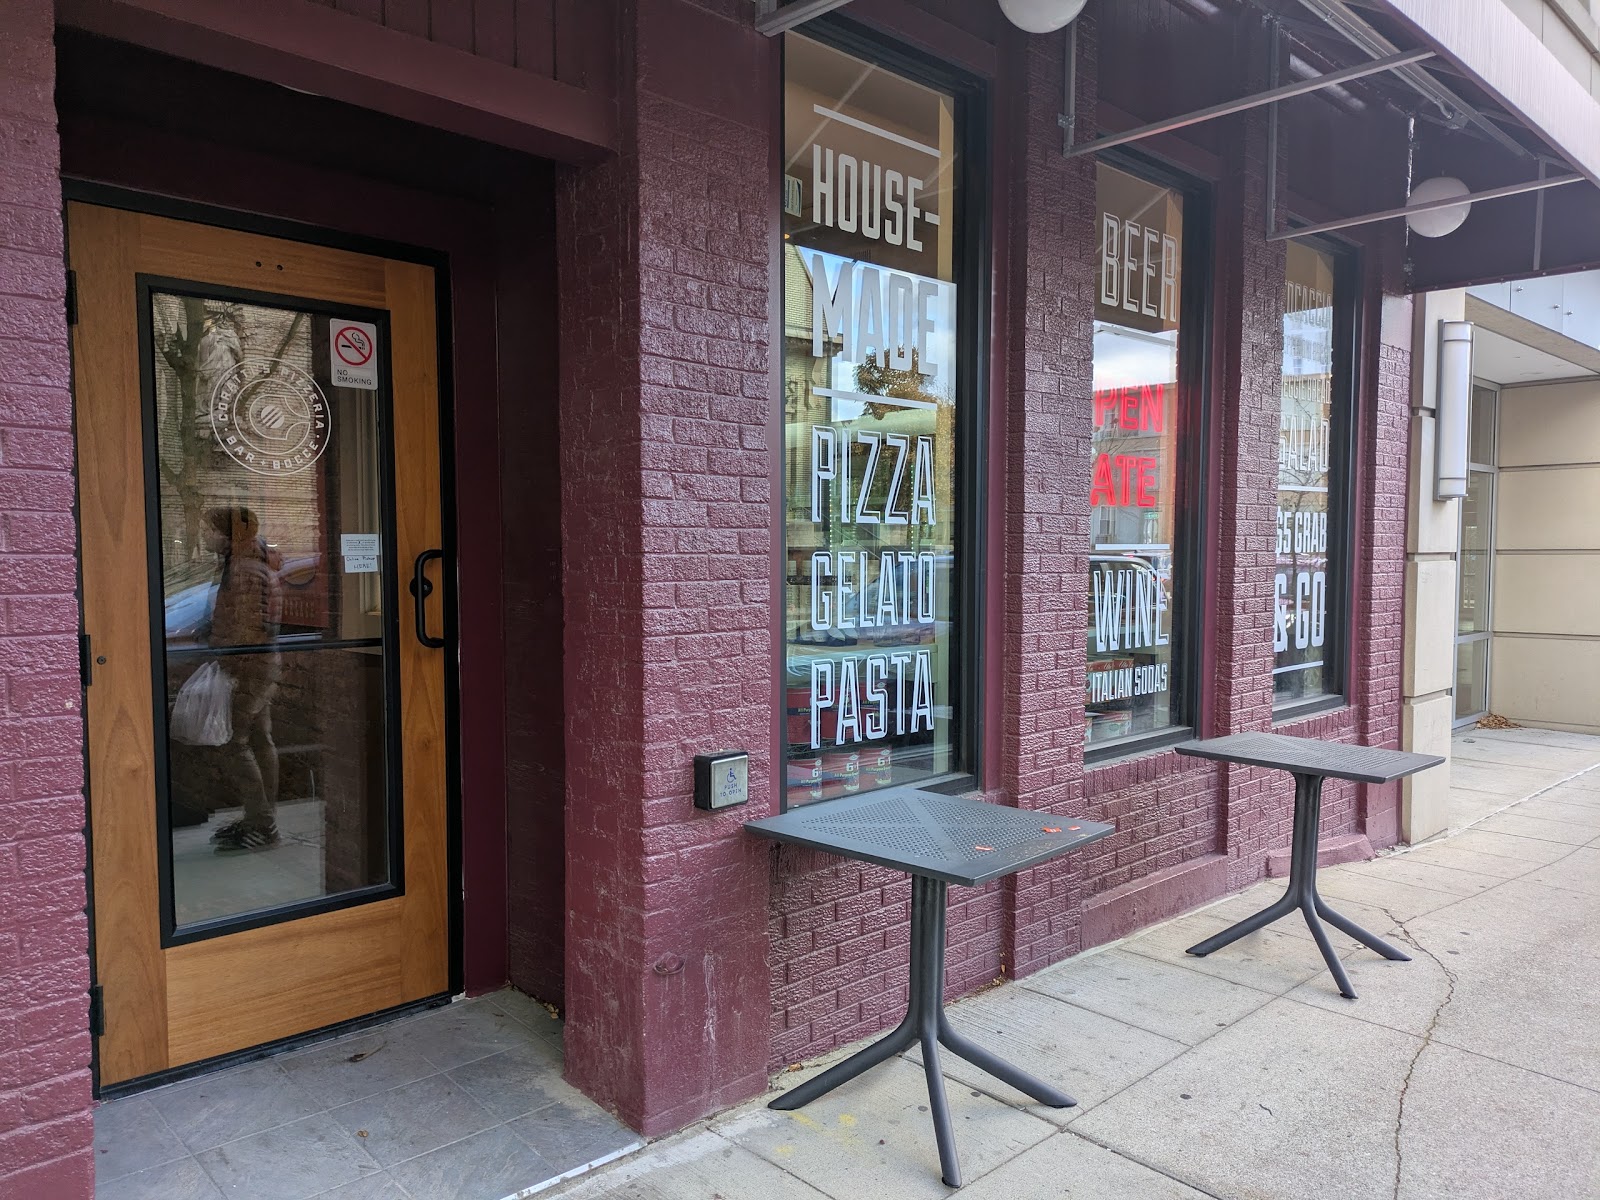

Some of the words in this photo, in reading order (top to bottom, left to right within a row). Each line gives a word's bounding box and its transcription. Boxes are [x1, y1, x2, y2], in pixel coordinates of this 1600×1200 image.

[812, 143, 940, 252] HOUSE-
[1101, 212, 1177, 322] BEER
[812, 254, 939, 376] MADE
[1285, 280, 1332, 329] OCACCIA
[280, 366, 325, 429] PIZZERIA
[337, 375, 372, 386] SMOKING
[1094, 380, 1164, 433] PEN
[226, 435, 256, 464] BAR
[272, 441, 319, 469] BOCCE
[1279, 412, 1330, 472] SALAD
[811, 425, 936, 525] PIZZA
[1090, 453, 1157, 507] ATE
[1275, 506, 1292, 557] $5
[1294, 511, 1328, 553] GRAB
[811, 551, 936, 631] GELATO
[1094, 569, 1172, 652] WINE
[1274, 573, 1288, 652] &
[1295, 571, 1326, 650] GO
[811, 649, 935, 750] PASTA
[1092, 667, 1133, 703] ITALIAN
[1134, 663, 1168, 696] SODAS
